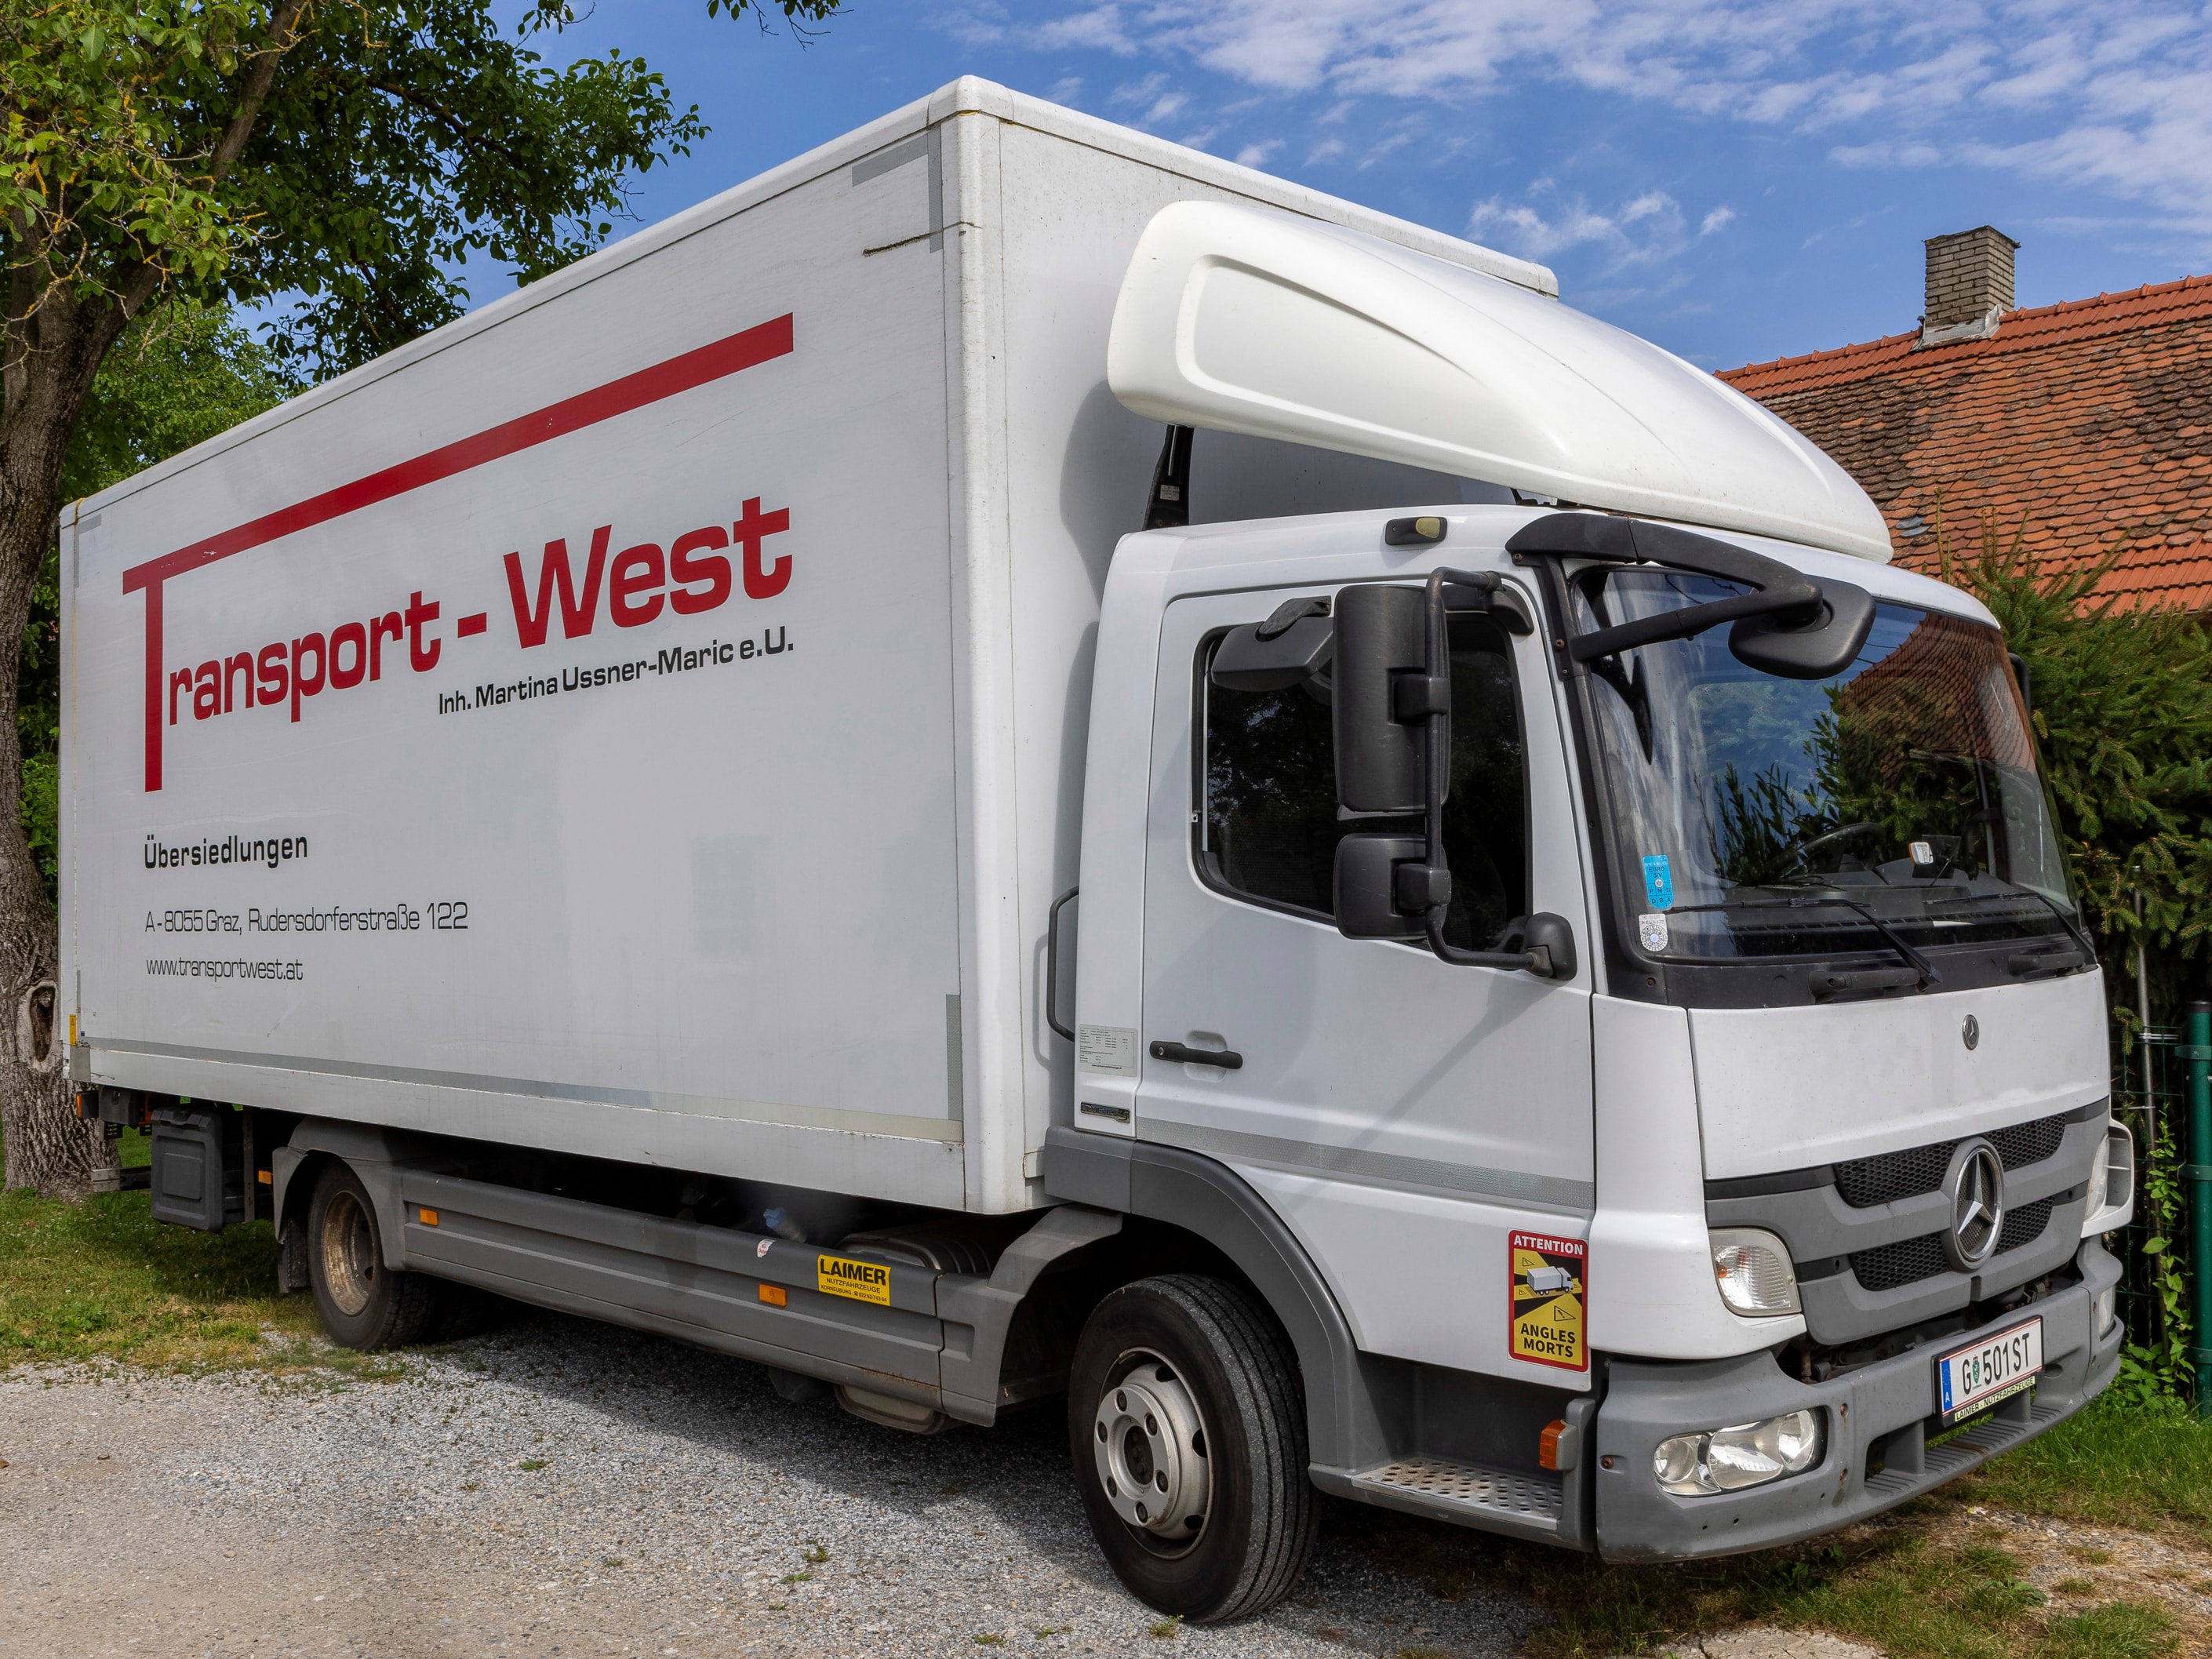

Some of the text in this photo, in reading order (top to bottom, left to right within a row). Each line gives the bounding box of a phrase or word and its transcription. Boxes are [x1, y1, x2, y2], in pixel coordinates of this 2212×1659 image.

[504, 496, 793, 649] West
[439, 625, 794, 715] Inh. Martina Ussner-Maric e.U.
[144, 835, 307, 868] Übersiedlungen
[206, 910, 242, 935] Graz,
[249, 904, 420, 932] Rudersdorferstraße
[427, 902, 468, 930] 122
[147, 957, 304, 982] www.transportwest.at
[1514, 1235, 1583, 1256] ATTENTION
[820, 1258, 886, 1286] LAIMER
[820, 1284, 852, 1295] KORNEUBURG
[826, 1277, 881, 1293] NUTZFAHRZEUGE
[1520, 1322, 1576, 1344] ANGLES
[1523, 1337, 1574, 1358] MORTS
[1945, 1392, 1950, 1403] A
[1956, 1403, 1980, 1421] LAIMER
[1983, 1377, 2034, 1406] NUTZFAHRZEUGE
